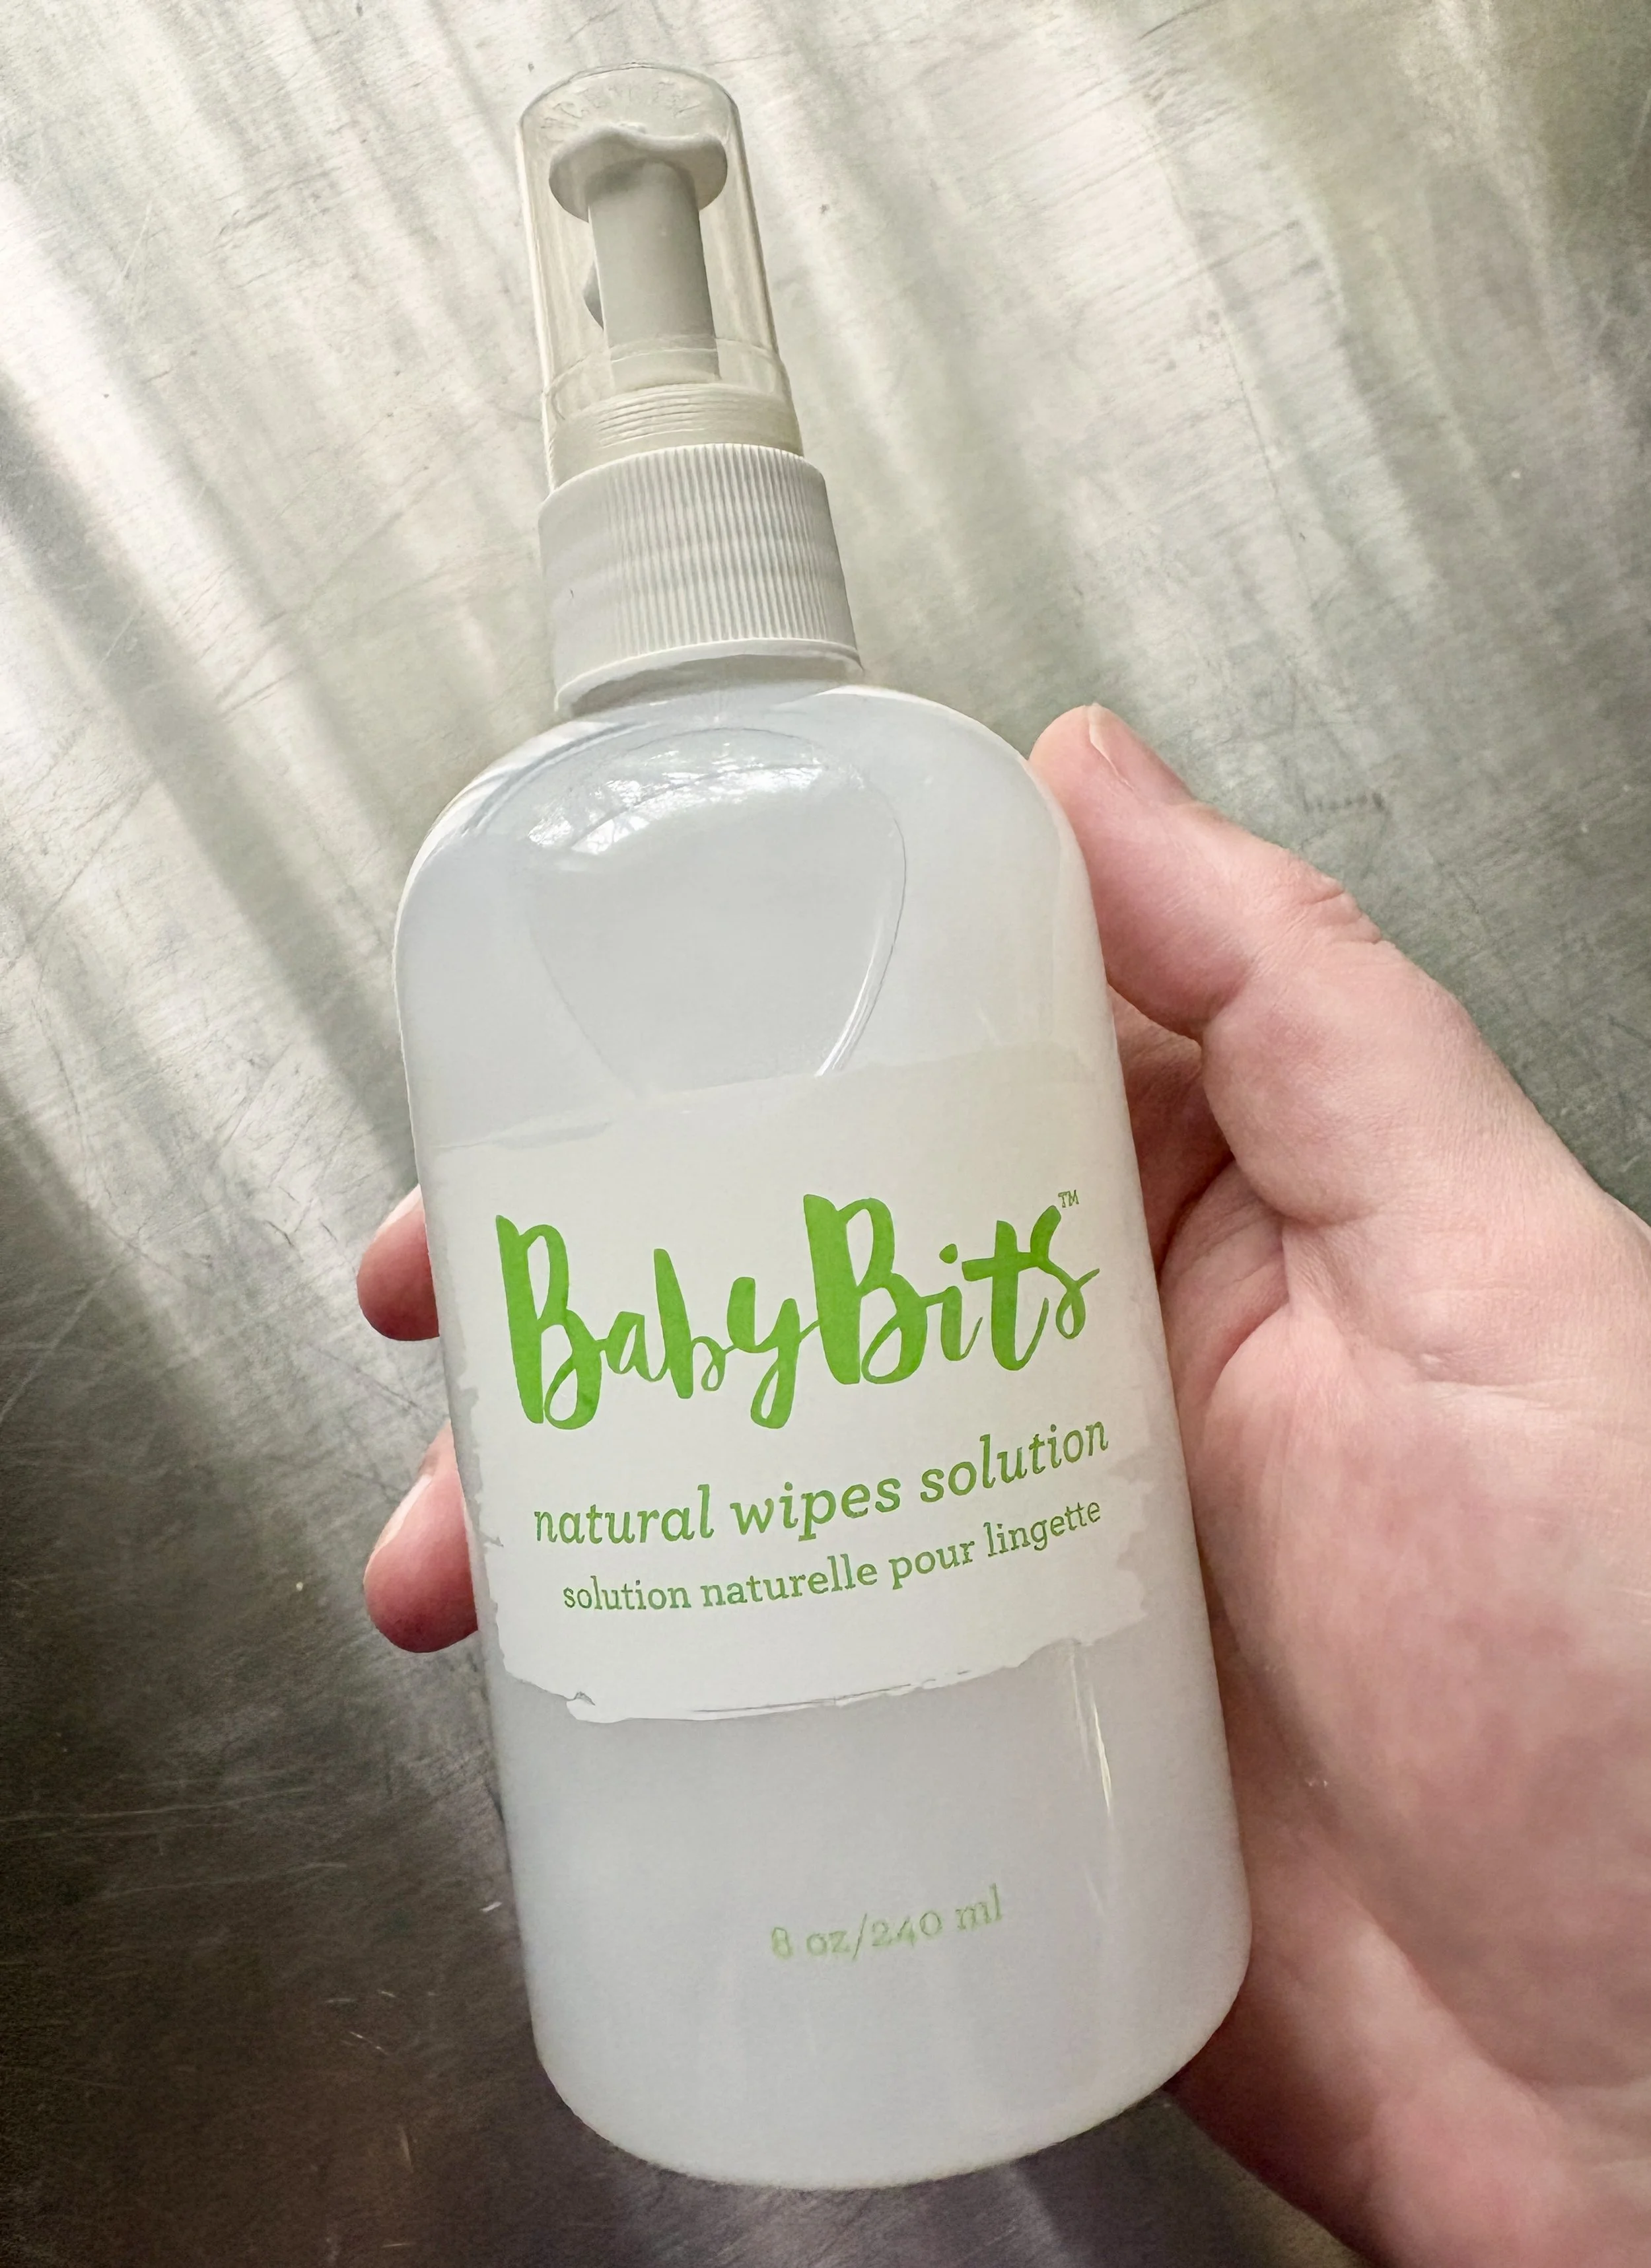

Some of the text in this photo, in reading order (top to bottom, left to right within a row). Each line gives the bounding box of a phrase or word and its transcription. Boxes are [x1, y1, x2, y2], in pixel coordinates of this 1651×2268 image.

[495, 1193, 1100, 1430] BabyBits
[534, 1421, 1109, 1544] natural wipes solution
[564, 1502, 1101, 1610] solution naturelle pour lingette
[771, 1882, 1002, 1961] 8 oz/240 ml
